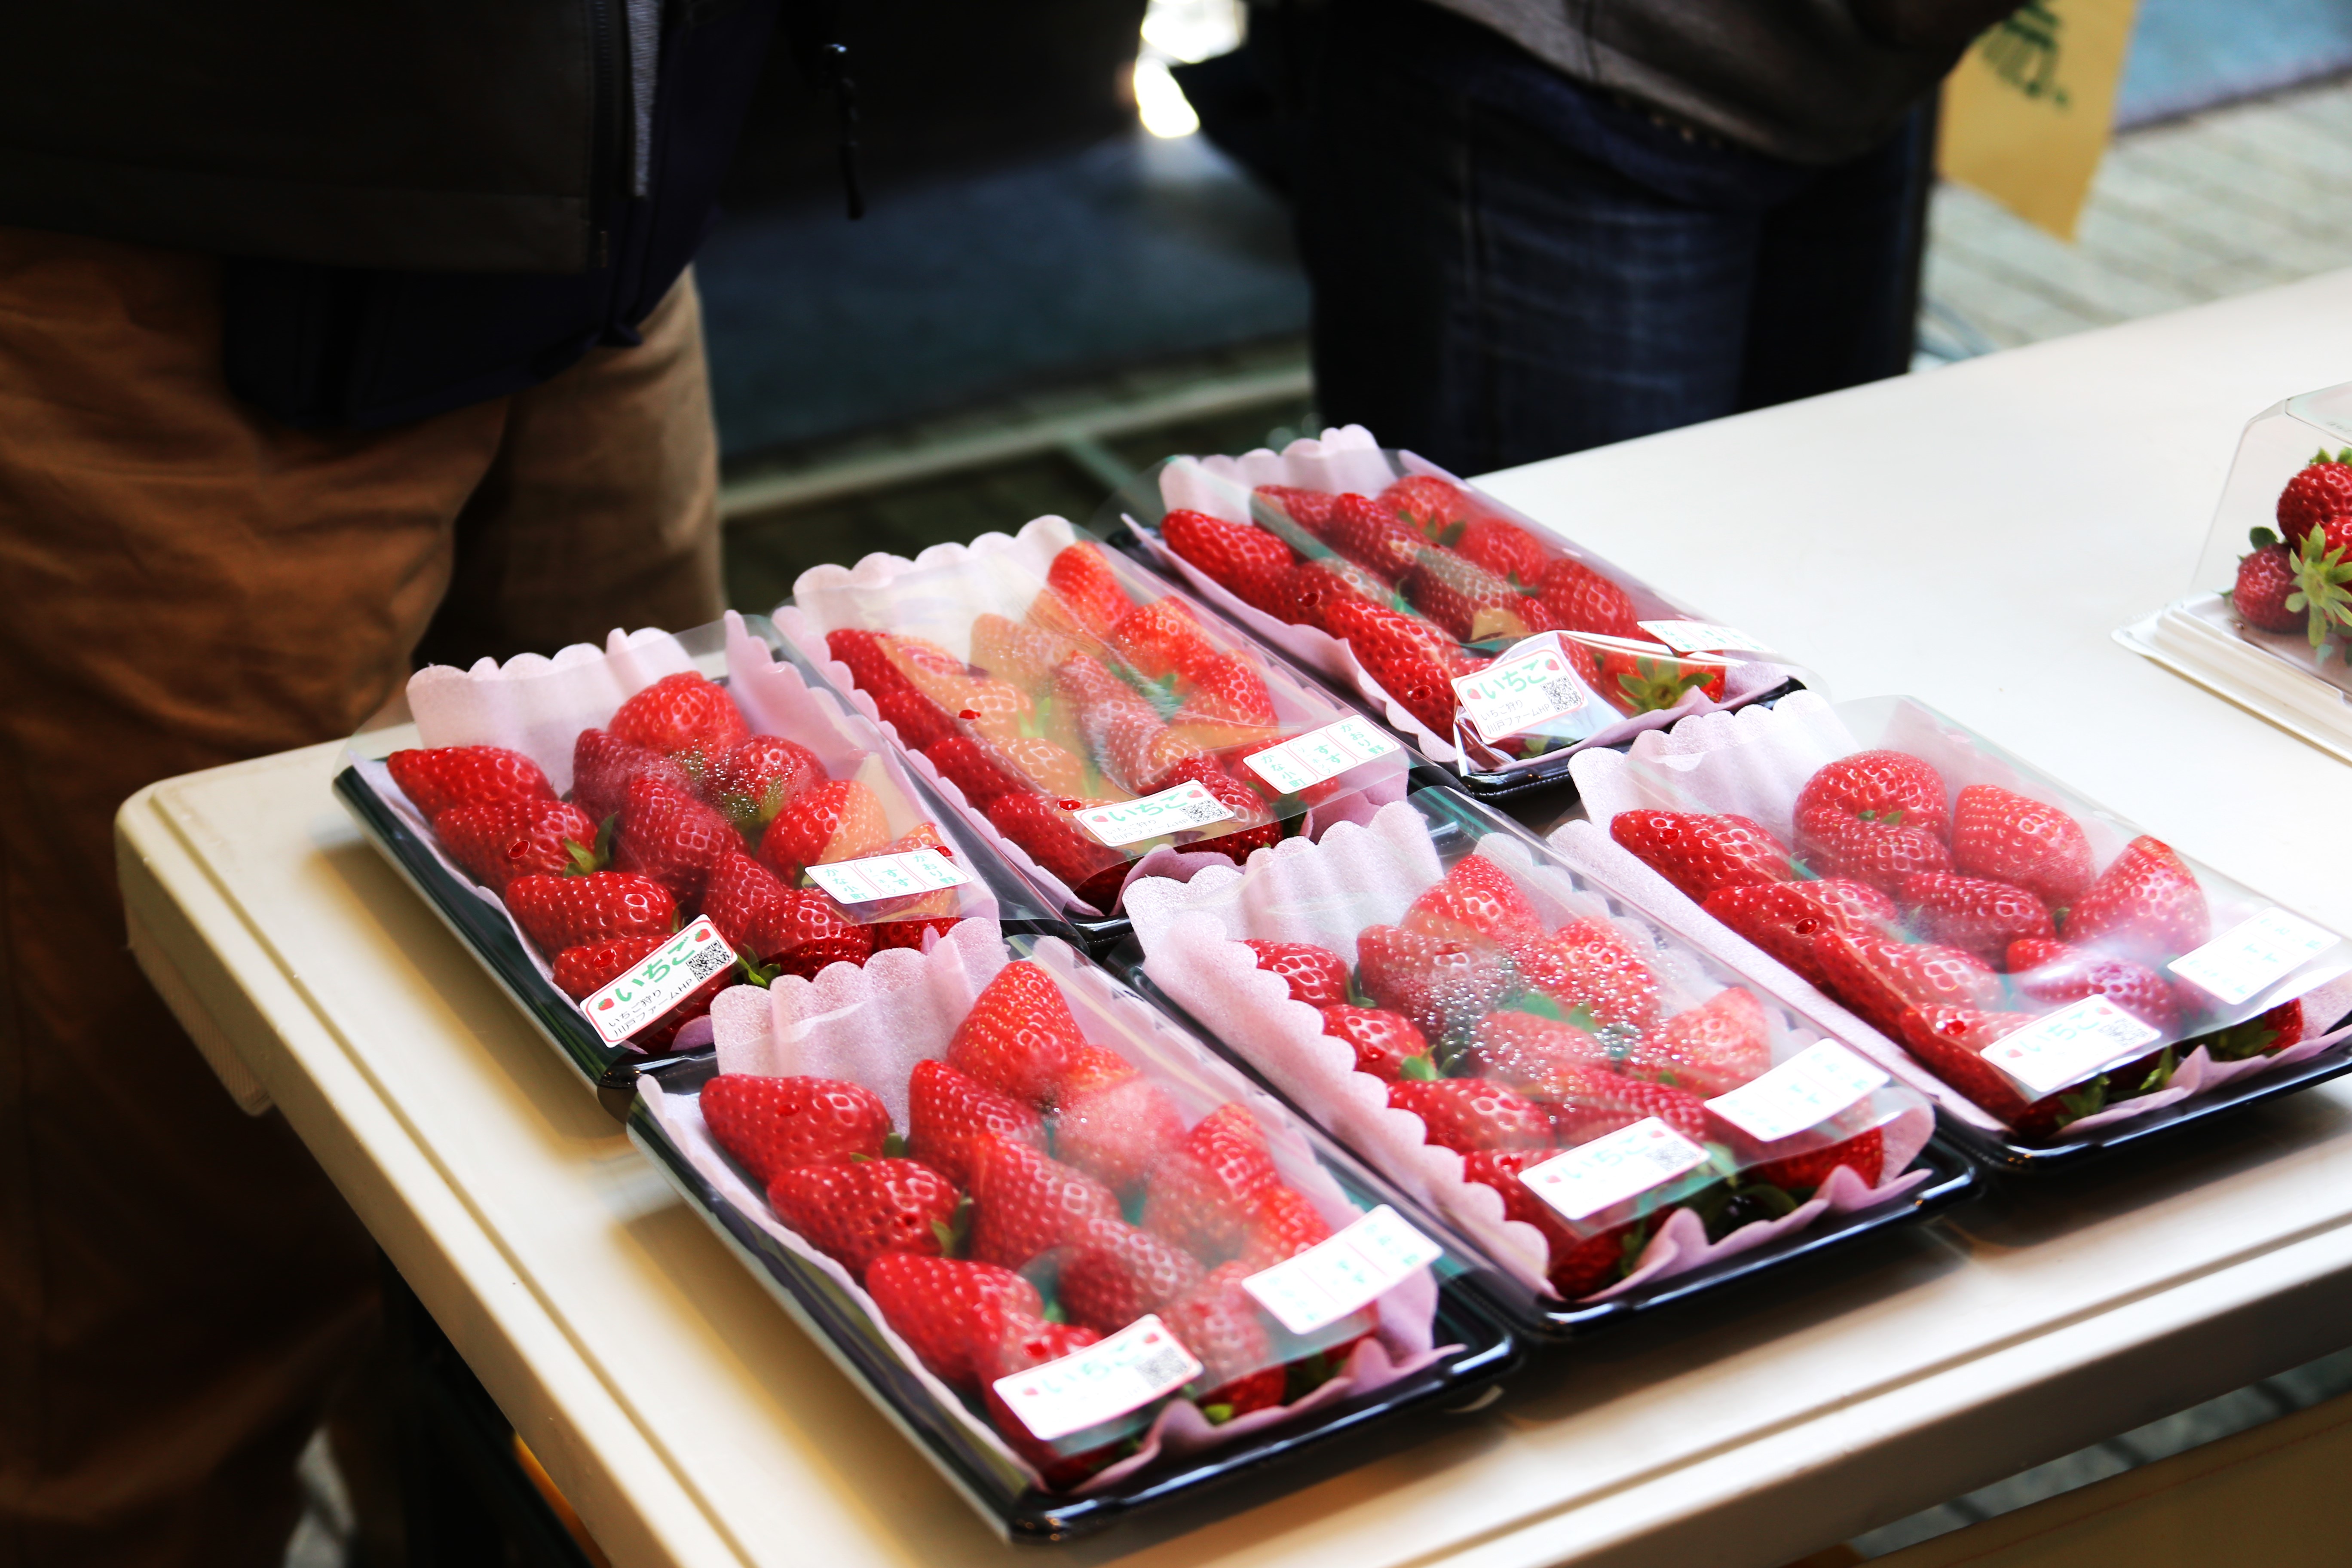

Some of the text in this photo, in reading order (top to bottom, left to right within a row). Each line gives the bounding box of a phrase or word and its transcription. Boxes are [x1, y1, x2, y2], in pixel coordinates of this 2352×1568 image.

[1479, 658, 1547, 700] いちご
[1480, 699, 1524, 721] いちご狩り
[1486, 704, 1550, 735] 川戸ファームHP
[1313, 743, 1341, 764] すず
[1339, 723, 1385, 755] かおり野
[1260, 753, 1307, 788] かな小町
[1107, 792, 1188, 822] いちご
[1105, 819, 1157, 835] いちご狩り
[824, 868, 871, 900] かな小町
[881, 868, 910, 887] すず
[913, 854, 957, 885] かおり野
[615, 936, 696, 1002] いちご
[608, 989, 662, 1027] いちご狩り
[613, 977, 693, 1037] 川戸ファームHP
[2018, 1010, 2101, 1053] いちご
